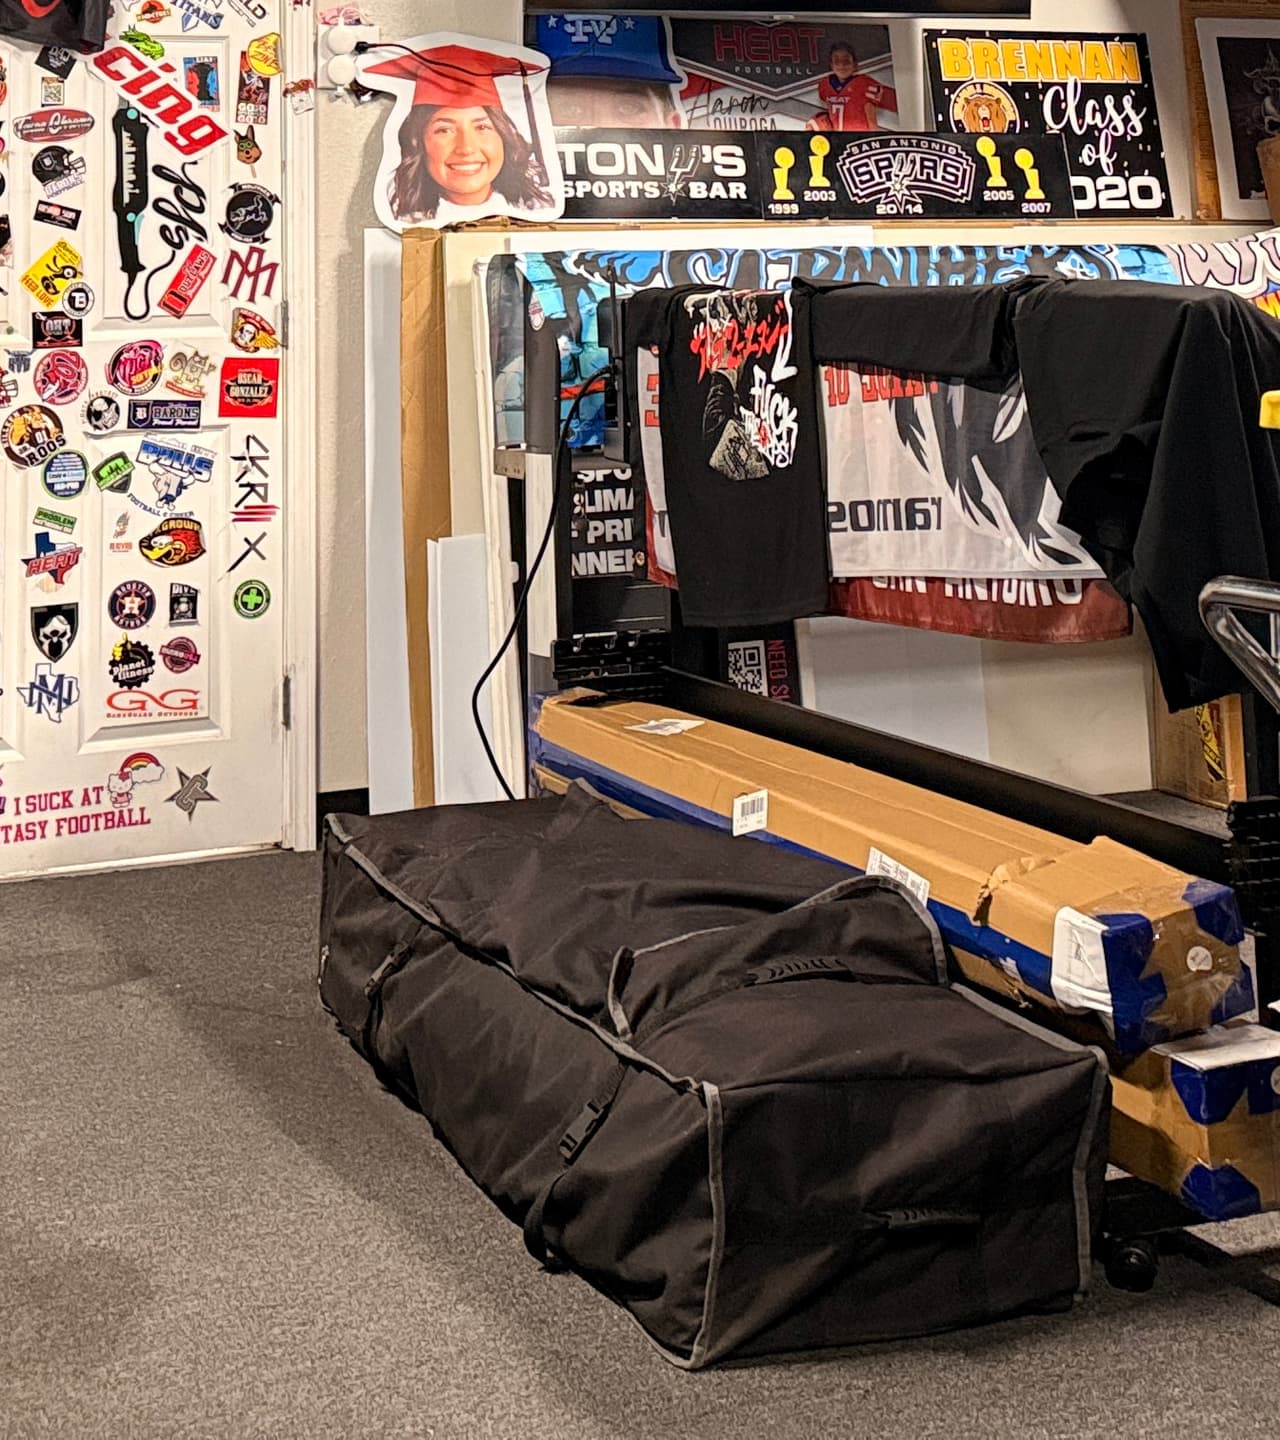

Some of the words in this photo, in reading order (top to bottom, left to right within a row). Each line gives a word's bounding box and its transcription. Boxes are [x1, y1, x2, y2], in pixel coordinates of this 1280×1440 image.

[713, 25, 825, 63] HEAT
[734, 65, 813, 75] FOOTBALL
[937, 38, 1142, 84] BRENNAN
[92, 45, 229, 156] cing
[1043, 76, 1147, 138] Class
[851, 140, 881, 154] SAN
[888, 138, 957, 156] ANTONIO
[1079, 129, 1118, 176] of
[852, 152, 963, 188] SPURS
[563, 180, 661, 200] SPORTS
[690, 181, 748, 200] BAR
[803, 190, 837, 202] 2003
[983, 189, 1015, 202] 2005
[1070, 175, 1163, 210] 020
[767, 203, 799, 215] 1999
[1021, 201, 1052, 214] 2007
[237, 372, 262, 385] OSCAR
[229, 385, 271, 398] GONZALEZ
[153, 406, 201, 420] BARONS
[28, 435, 67, 465] ROOS
[36, 509, 77, 528] PROBLEM
[25, 789, 74, 814] SUCK
[81, 785, 104, 807] AT
[56, 806, 151, 837] FOOTBALL
